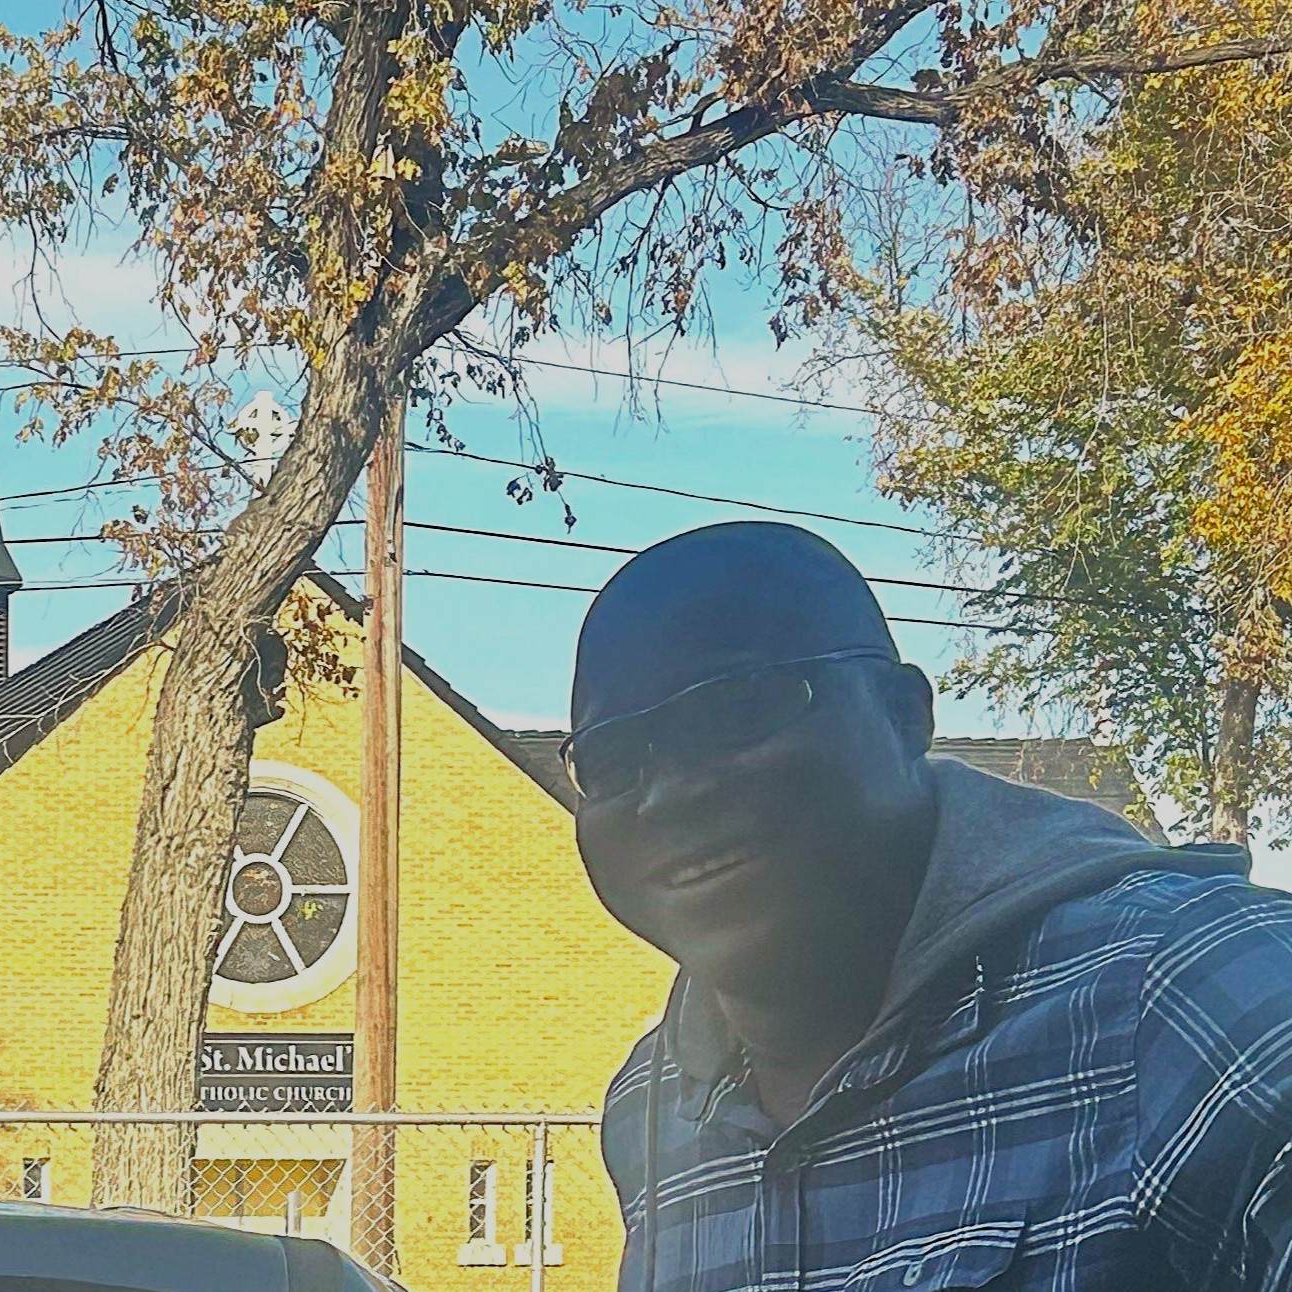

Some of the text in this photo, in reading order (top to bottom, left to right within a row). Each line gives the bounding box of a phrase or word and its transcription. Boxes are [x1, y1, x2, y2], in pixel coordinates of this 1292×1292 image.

[200, 1044, 352, 1072] St. Michael'
[200, 1086, 352, 1101] THOLIC CHURCH
